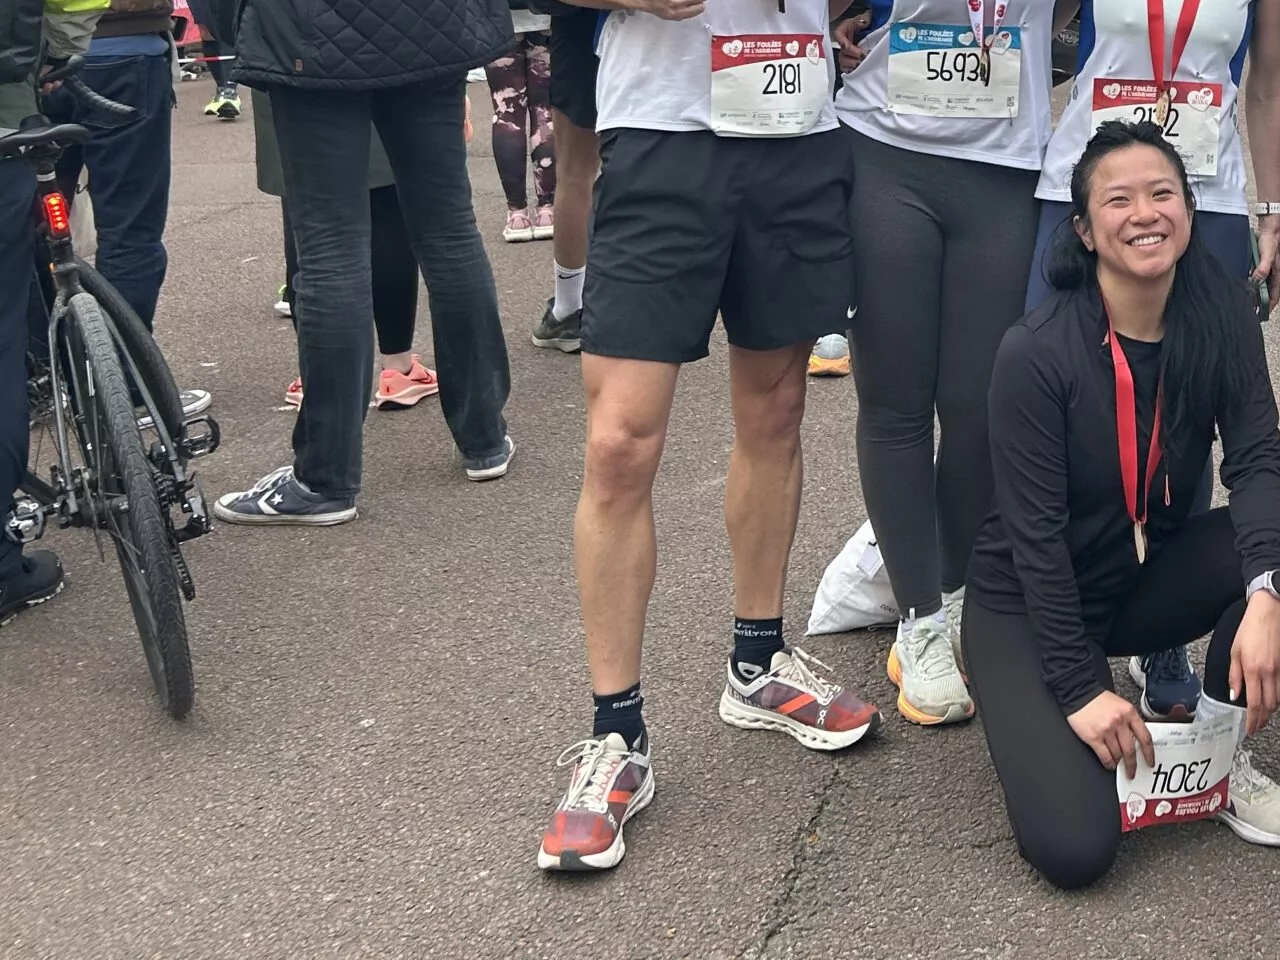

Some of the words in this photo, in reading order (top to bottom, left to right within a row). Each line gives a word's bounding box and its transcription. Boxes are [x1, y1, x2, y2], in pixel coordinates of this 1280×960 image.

[762, 63, 801, 94] 2181
[926, 51, 980, 81] 5693
[1133, 106, 1180, 137] 212
[1151, 758, 1212, 794] 2304
